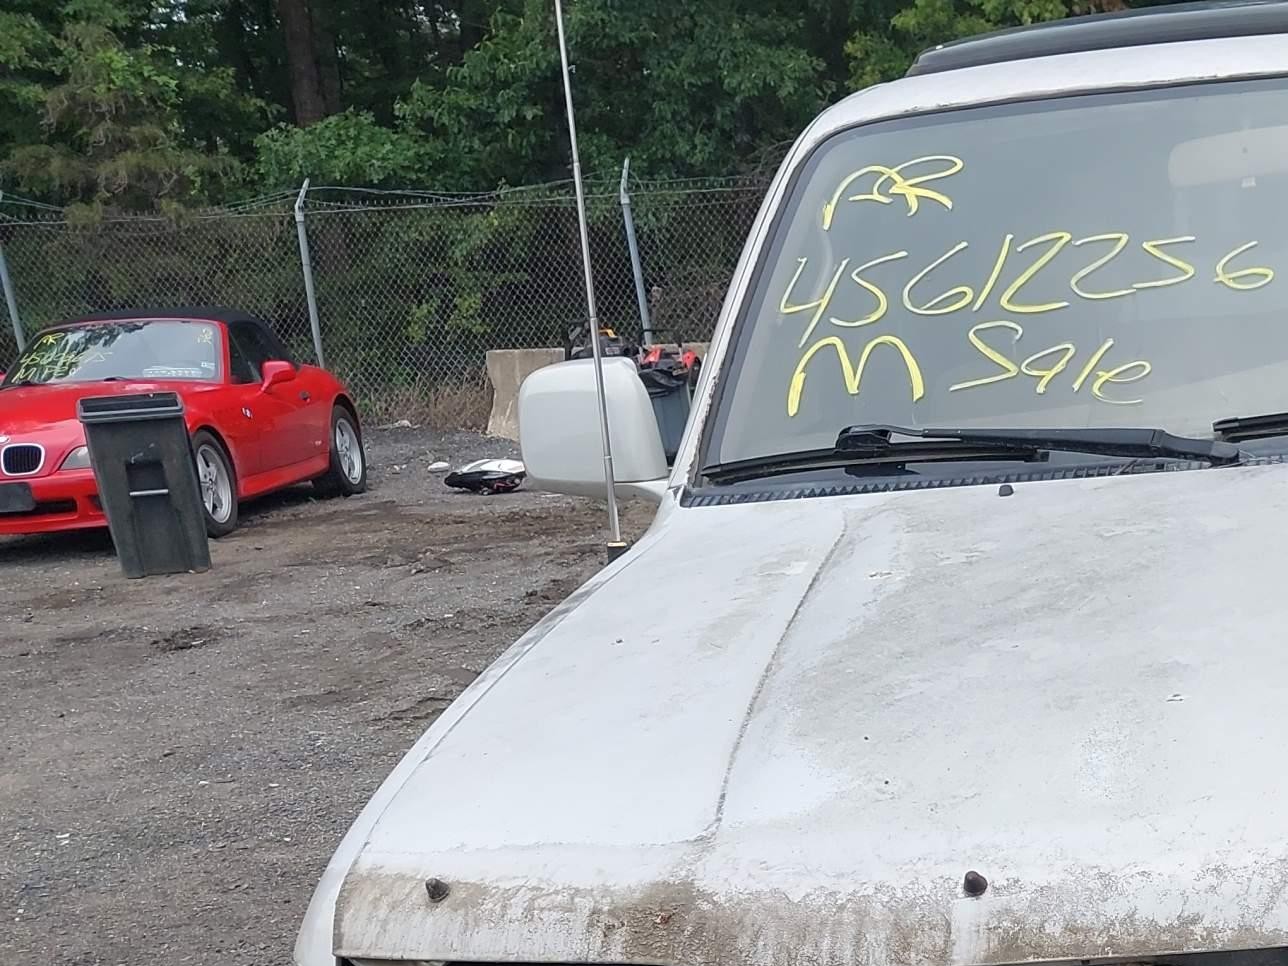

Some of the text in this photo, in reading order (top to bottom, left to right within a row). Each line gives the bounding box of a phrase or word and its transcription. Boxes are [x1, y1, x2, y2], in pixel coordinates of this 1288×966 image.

[778, 231, 1275, 348] 45612256
[786, 320, 1153, 418] M Sale
